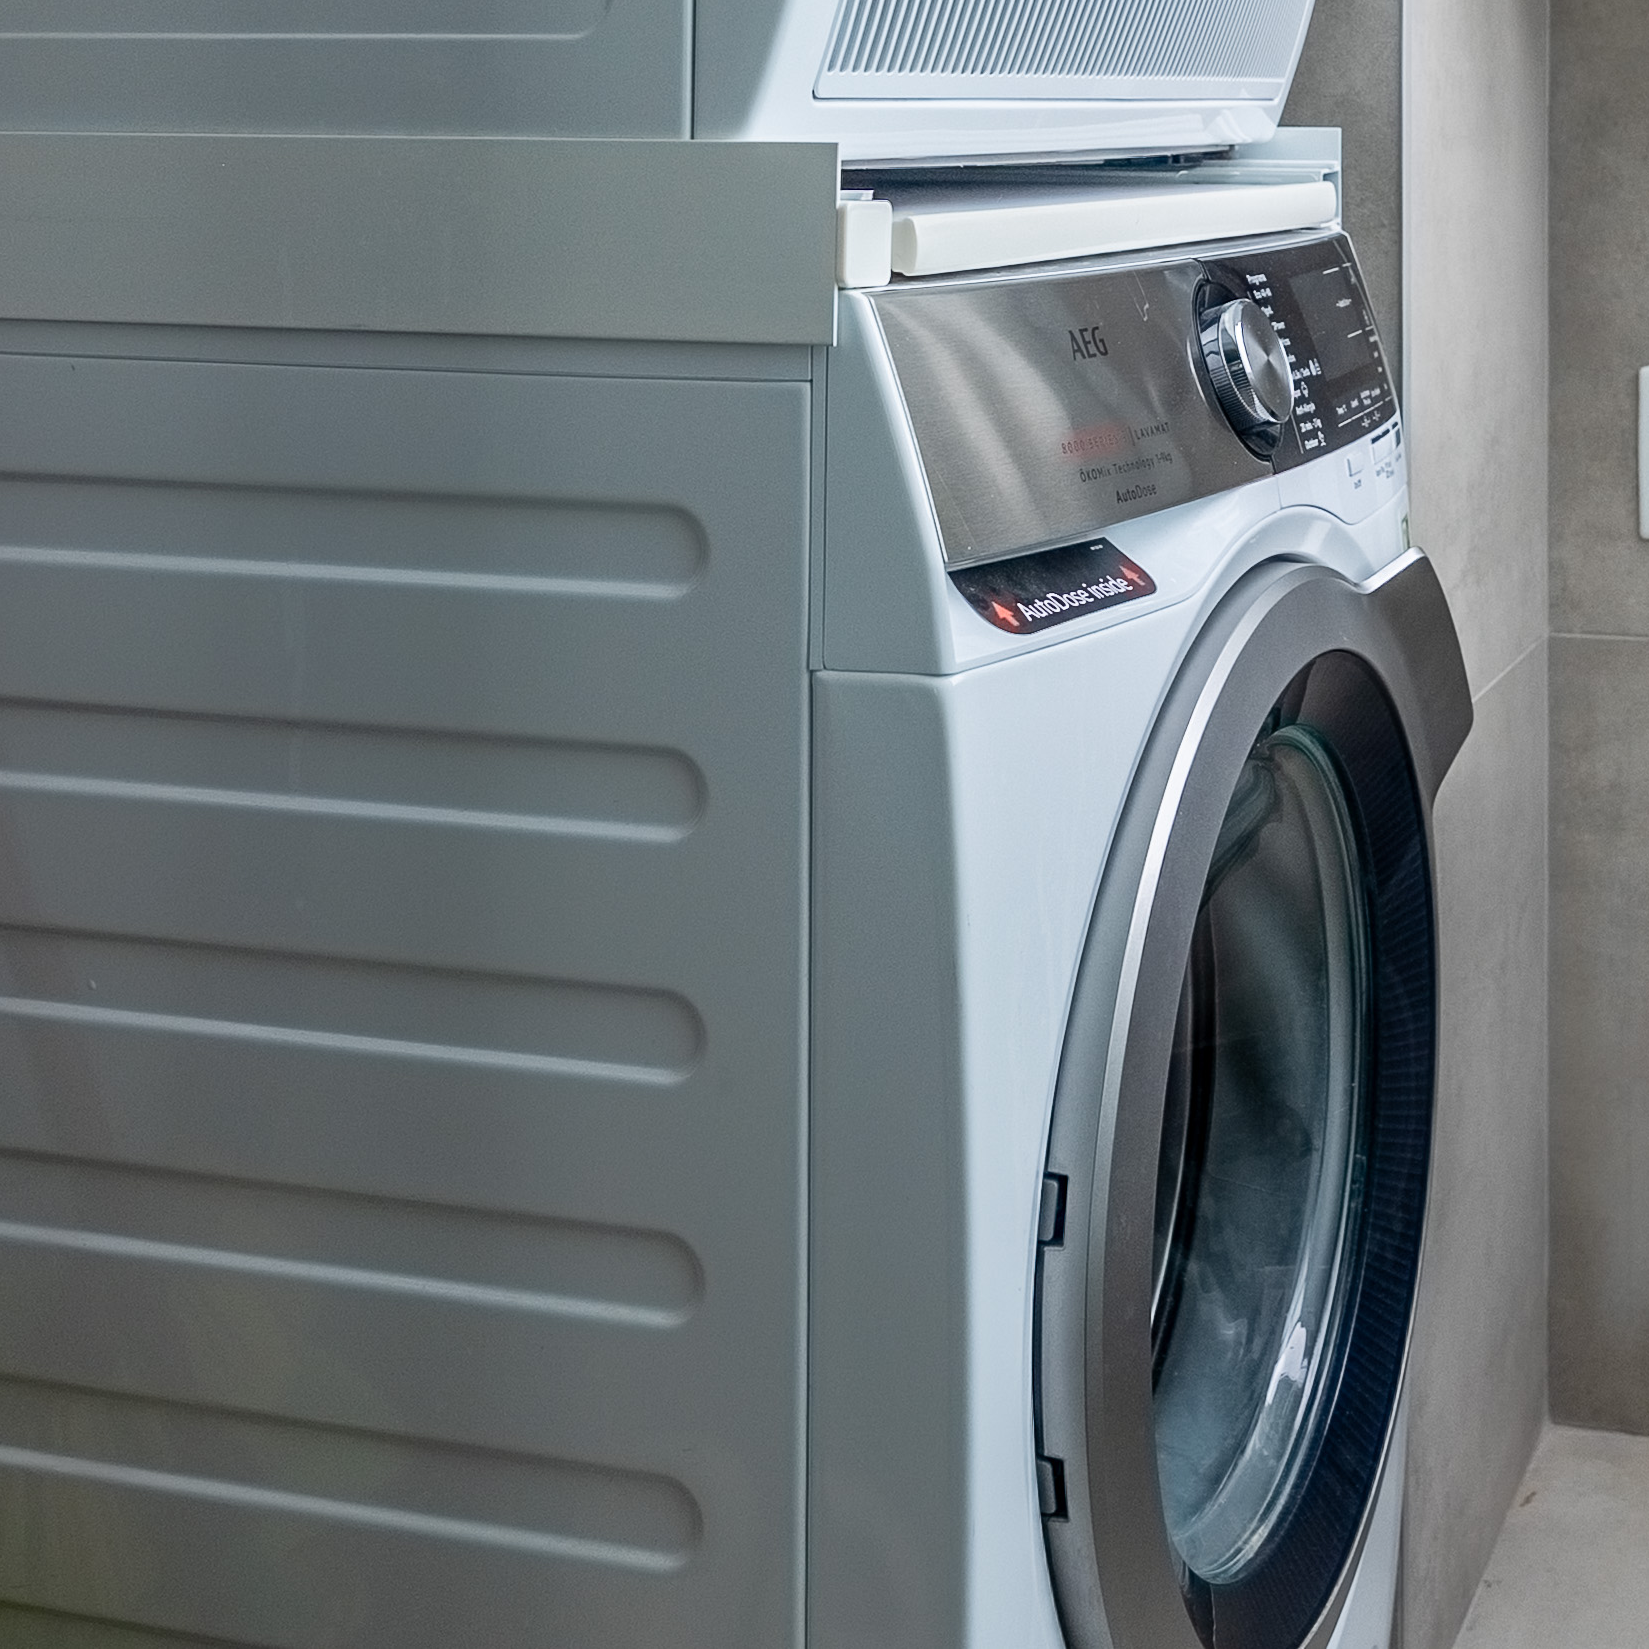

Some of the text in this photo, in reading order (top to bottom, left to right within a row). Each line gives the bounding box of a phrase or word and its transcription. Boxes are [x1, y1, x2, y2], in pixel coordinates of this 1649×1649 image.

[1068, 326, 1109, 361] AEG
[1134, 421, 1170, 441] LAVAMAT
[1114, 483, 1157, 505] AutoDose
[1017, 574, 1134, 622] AutoDose inside
